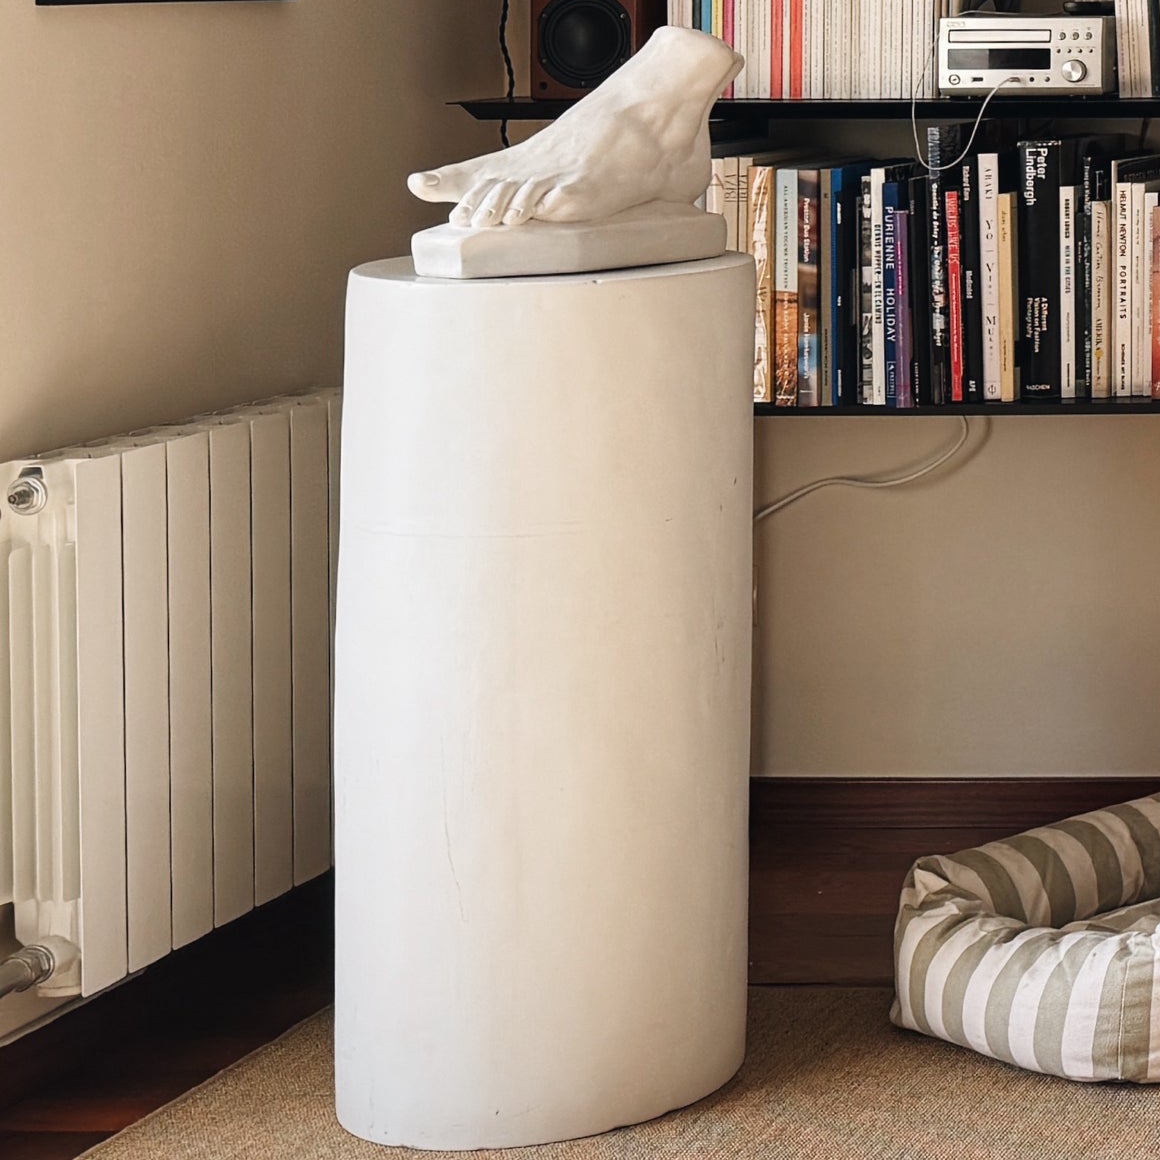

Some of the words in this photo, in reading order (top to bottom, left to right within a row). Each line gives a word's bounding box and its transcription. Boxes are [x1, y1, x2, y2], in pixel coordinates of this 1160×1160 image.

[962, 165, 971, 186] Richard
[1024, 148, 1037, 206] Lindbergh
[1036, 148, 1048, 179] Peter
[985, 167, 993, 201] ARAKI
[1119, 190, 1127, 220] HELMUT
[803, 238, 811, 262] Station
[885, 206, 895, 270] PURIENNE
[1119, 223, 1127, 257] NEWTON
[1033, 298, 1041, 316] Vision
[1119, 265, 1127, 320] PORTRAITS
[885, 289, 896, 342] HOLIDAY
[1033, 327, 1041, 353] Fashion
